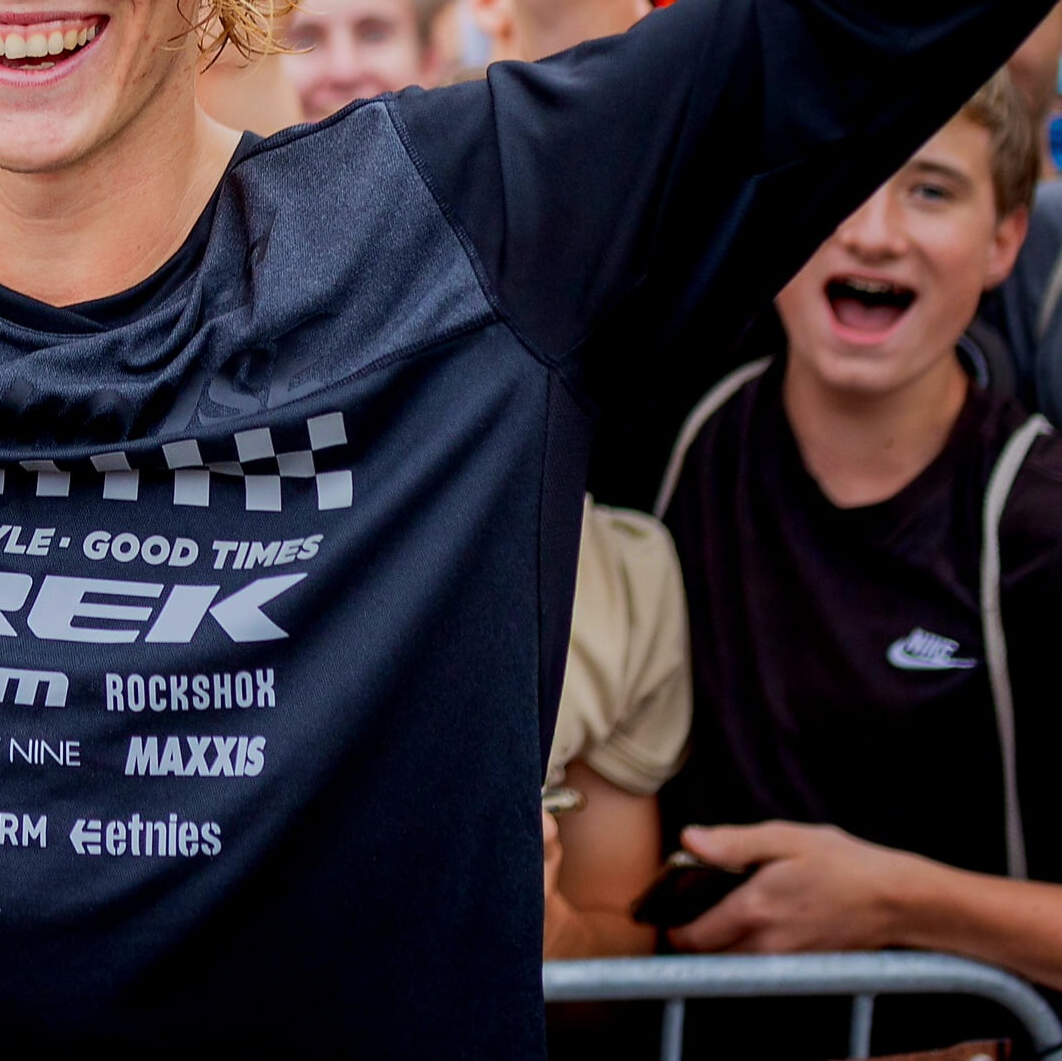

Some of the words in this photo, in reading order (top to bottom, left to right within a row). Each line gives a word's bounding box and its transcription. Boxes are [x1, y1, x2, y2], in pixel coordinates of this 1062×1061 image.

[82, 530, 199, 567] GOOD
[211, 534, 325, 570] TIMES
[905, 627, 960, 660] NIKE
[105, 668, 276, 712] ROCKSHOX
[9, 737, 81, 766] NINE
[124, 735, 267, 777] MAXXIS
[105, 813, 222, 857] etnies
